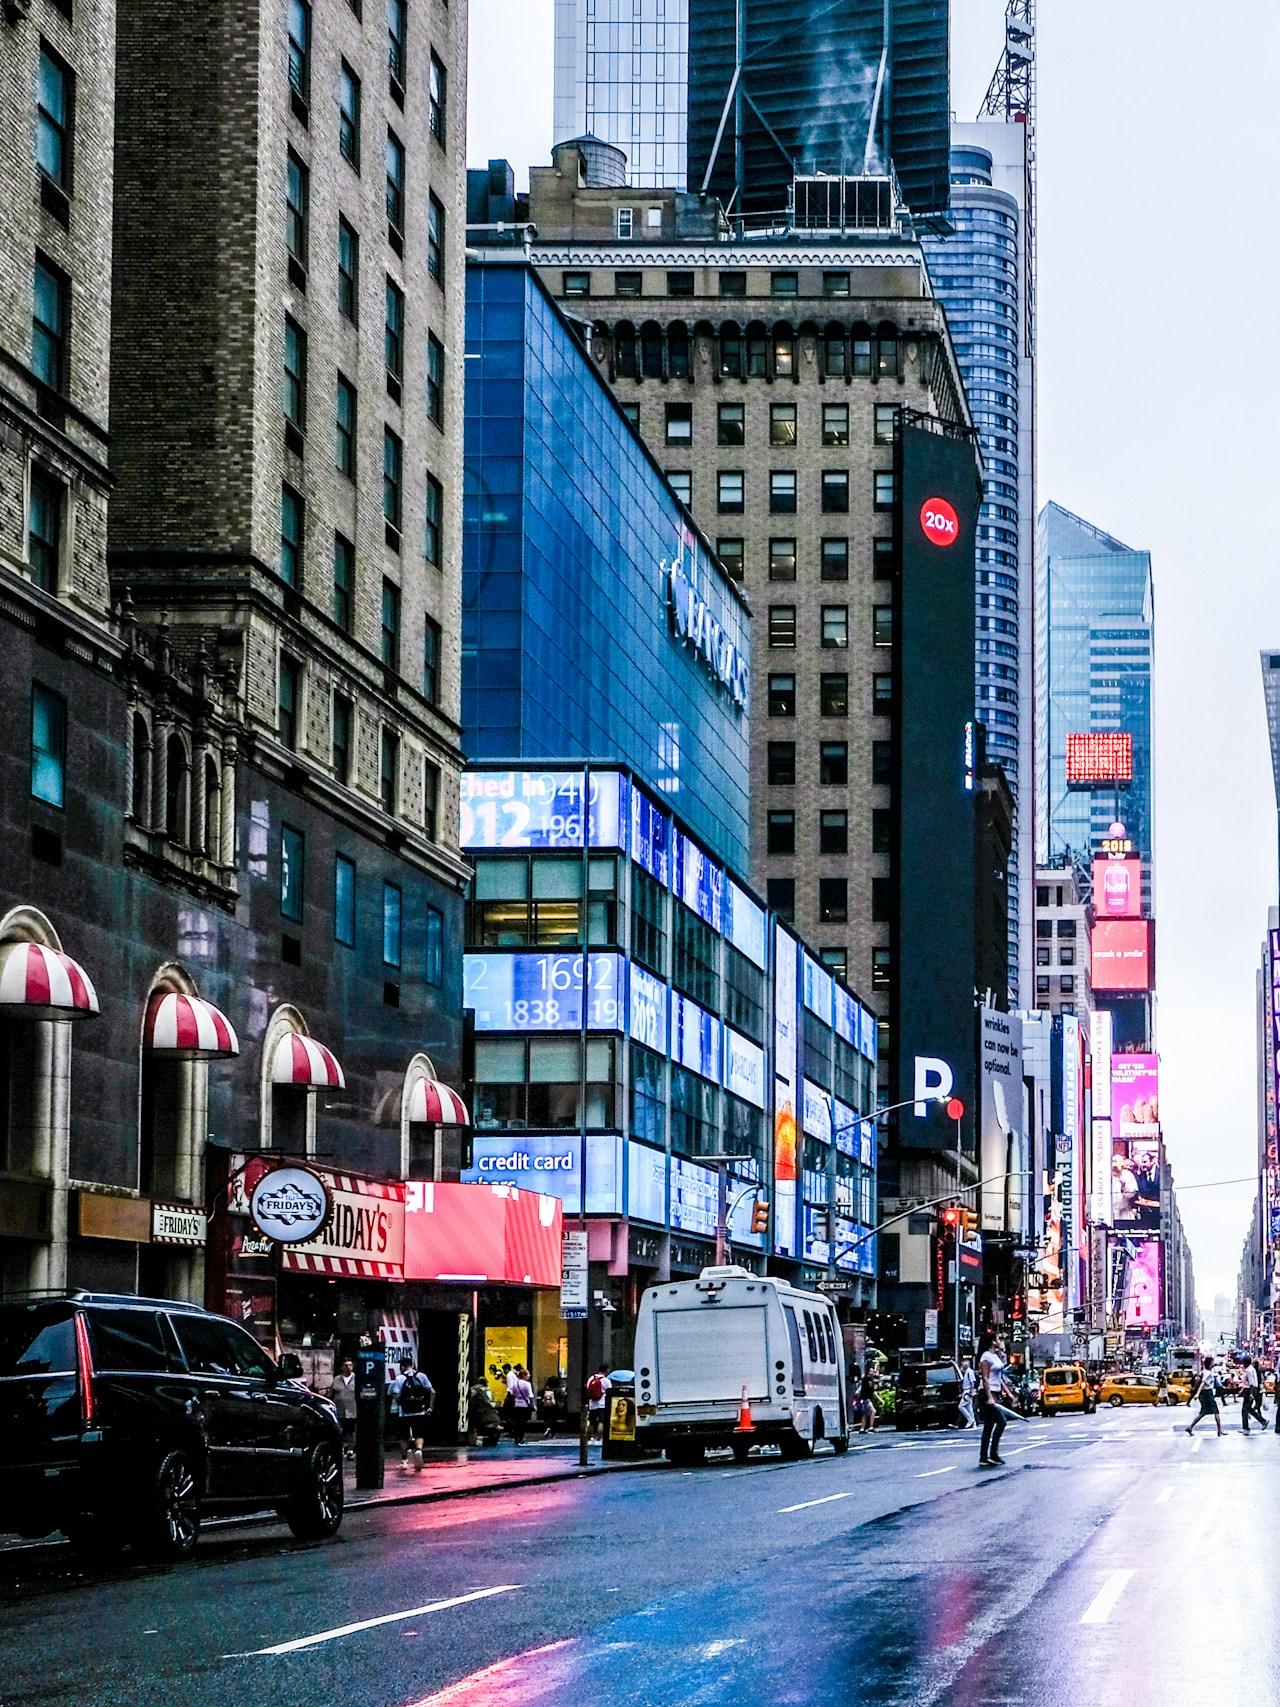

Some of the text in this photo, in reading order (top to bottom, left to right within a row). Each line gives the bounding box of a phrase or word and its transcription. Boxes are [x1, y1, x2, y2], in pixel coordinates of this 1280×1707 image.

[925, 511, 953, 533] 20x
[1102, 840, 1132, 853] 2018
[536, 957, 613, 991] 1692
[504, 1000, 560, 1024] 1838
[984, 1017, 1010, 1035] wrinkles
[984, 1041, 1019, 1058] can now be
[478, 1152, 572, 1171] credit card
[266, 1201, 314, 1211] FRIDAY'S
[163, 1216, 199, 1237] FRIDAY'S
[365, 1361, 375, 1374] P
